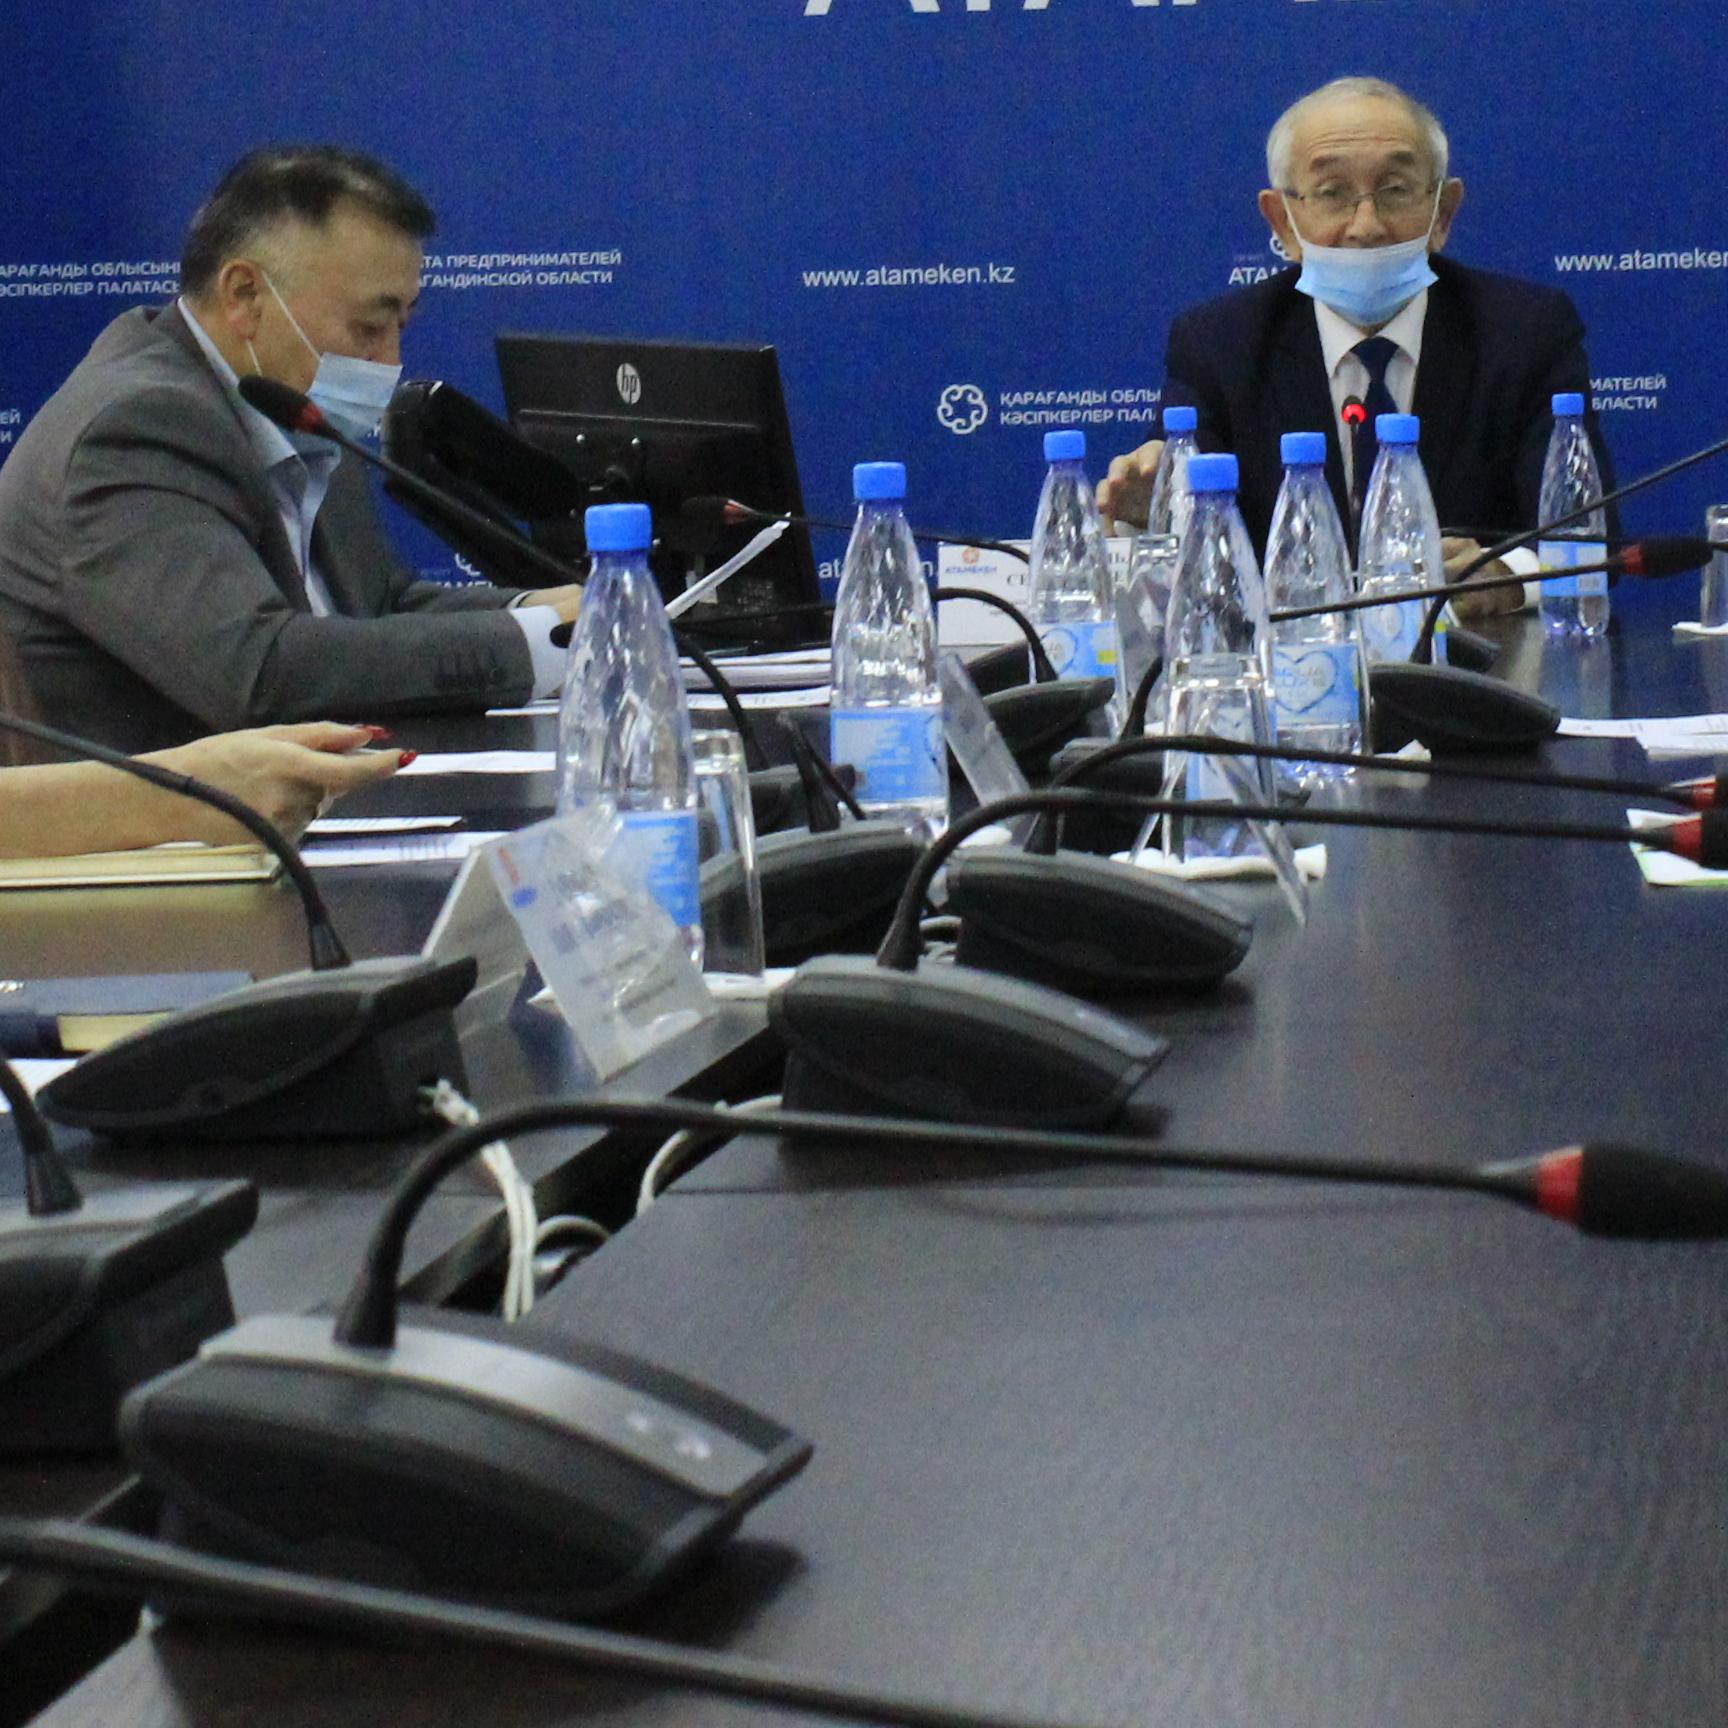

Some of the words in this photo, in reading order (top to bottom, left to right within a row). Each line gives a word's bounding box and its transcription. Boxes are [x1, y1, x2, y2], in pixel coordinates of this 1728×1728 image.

[447, 248, 622, 270] ПРЕДПРИНИМАТЕЛЕЙ
[536, 270, 614, 286] ОБЛАСТИ
[802, 263, 1016, 287] www.atameken.kz
